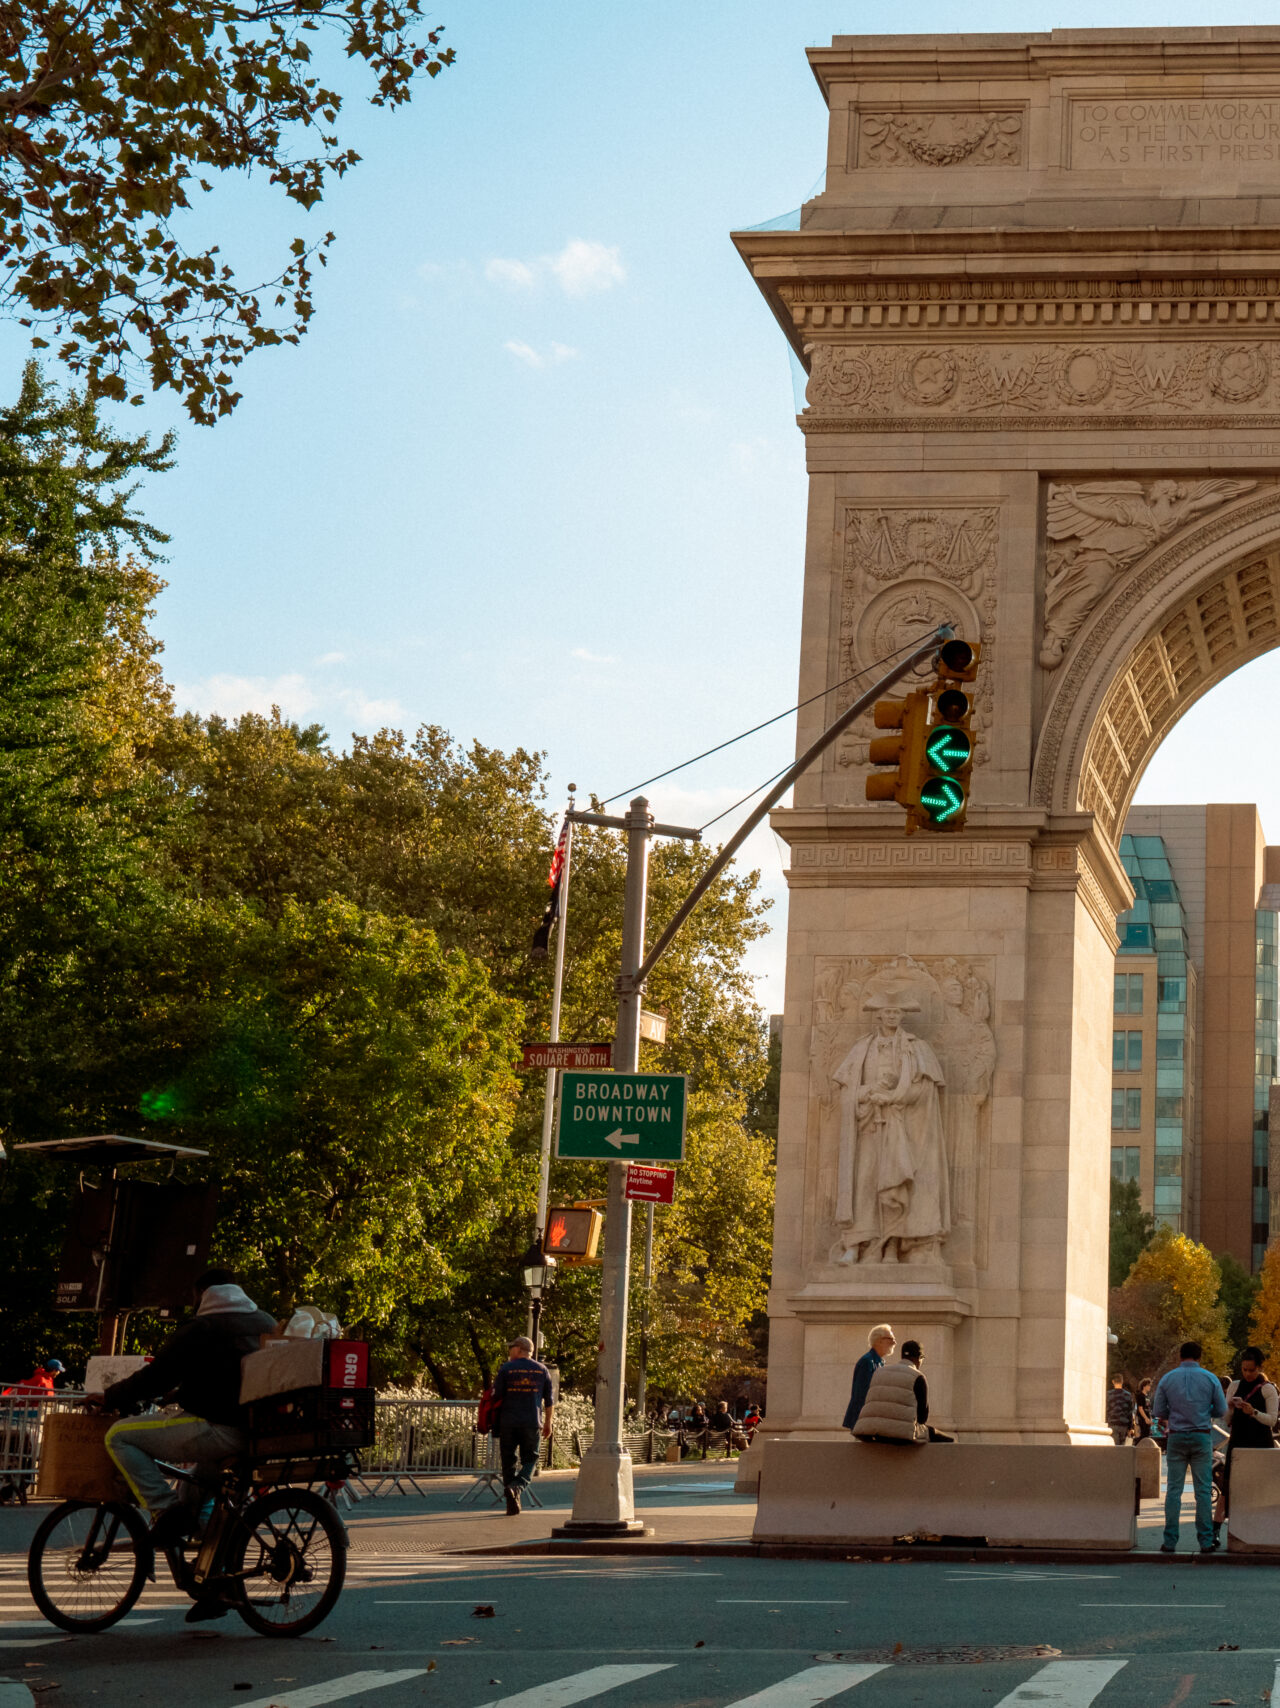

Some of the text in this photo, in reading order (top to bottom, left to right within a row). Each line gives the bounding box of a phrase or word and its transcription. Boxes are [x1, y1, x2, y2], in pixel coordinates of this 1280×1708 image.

[1078, 105, 1108, 122] TO
[1080, 126, 1112, 142] OF
[1120, 125, 1168, 142] THE
[1100, 146, 1130, 162] AS
[1143, 145, 1209, 162] FIRST
[1127, 445, 1209, 456] ERECTED
[1217, 444, 1237, 456] BY
[1248, 444, 1280, 455] THE
[529, 1053, 607, 1066] SQUARE NORTH
[575, 1083, 669, 1100] BROADWAY
[573, 1106, 671, 1123] DOWNTOWN
[629, 1176, 653, 1185] Anytime
[639, 1170, 667, 1179] STOPPING
